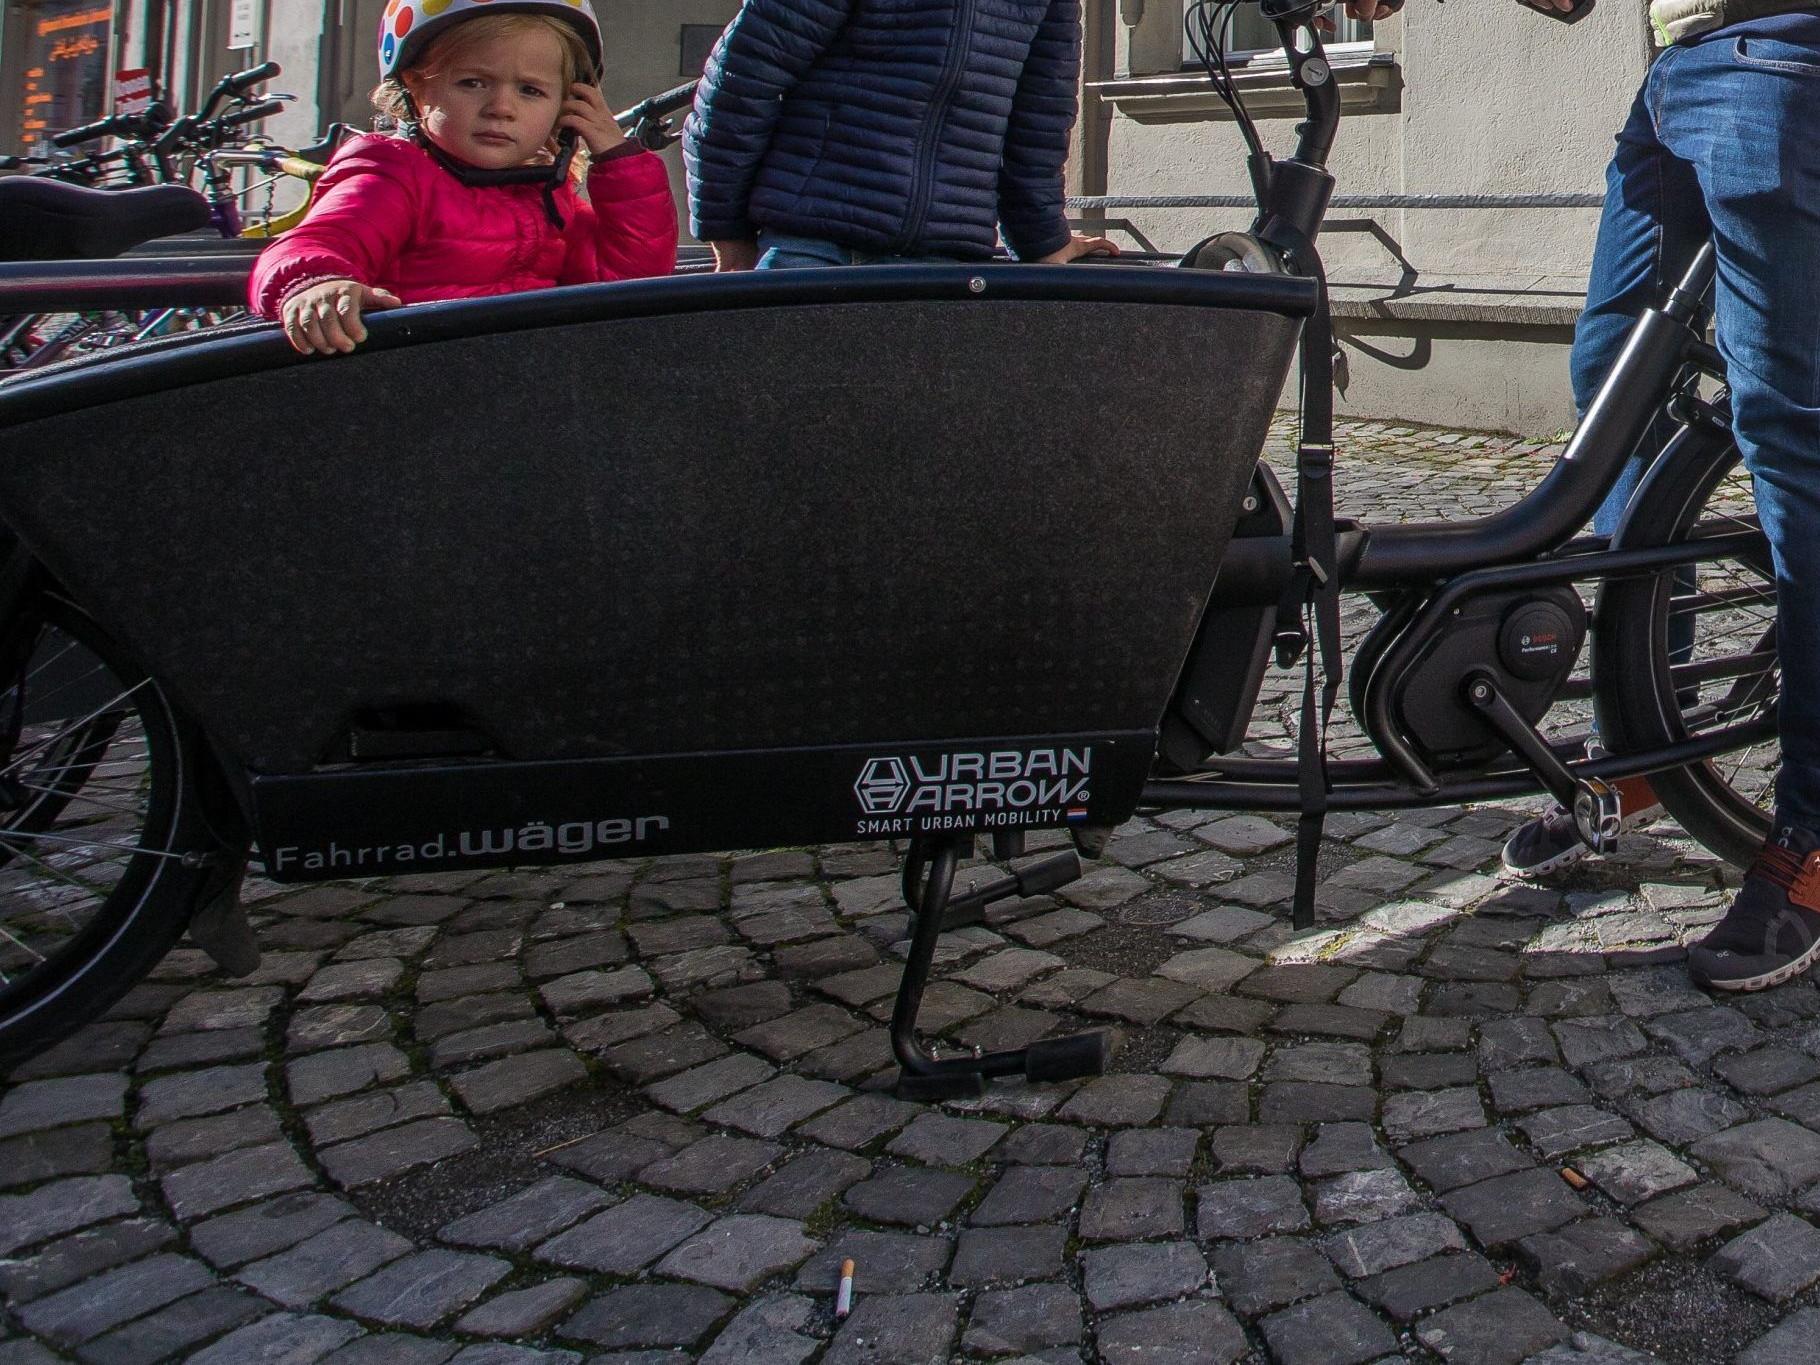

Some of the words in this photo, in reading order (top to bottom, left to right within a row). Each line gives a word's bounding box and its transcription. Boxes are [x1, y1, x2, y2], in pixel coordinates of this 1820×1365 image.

[909, 746, 1091, 782] URBAN
[857, 818, 913, 834] SMART
[921, 814, 975, 830] URBAN
[984, 809, 1061, 826] MOBILITY
